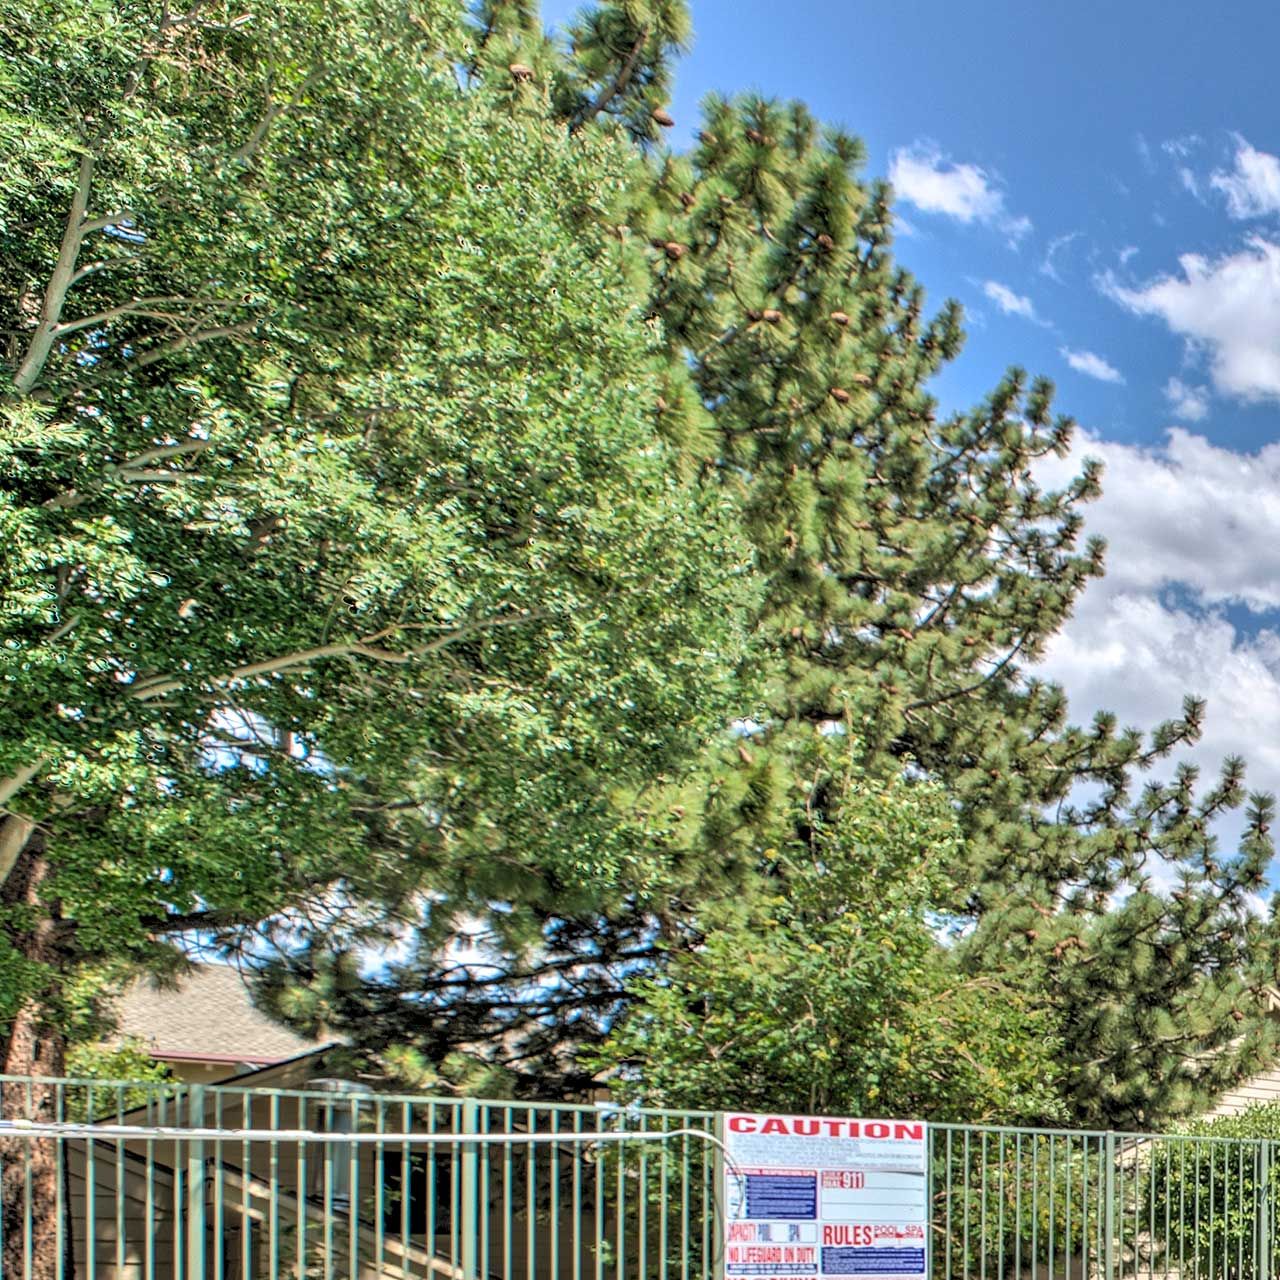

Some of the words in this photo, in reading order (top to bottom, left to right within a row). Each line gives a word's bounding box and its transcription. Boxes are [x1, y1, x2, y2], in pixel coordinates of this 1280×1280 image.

[728, 1117, 923, 1140] CAUTION
[842, 1171, 863, 1188] 911
[823, 1225, 872, 1246] RULES
[874, 1224, 898, 1234] POOL
[905, 1224, 923, 1235] SPA
[729, 1246, 739, 1263] NO
[742, 1246, 782, 1263] LIFEGUARD
[784, 1246, 794, 1263] ON
[797, 1246, 814, 1263] DUTY
